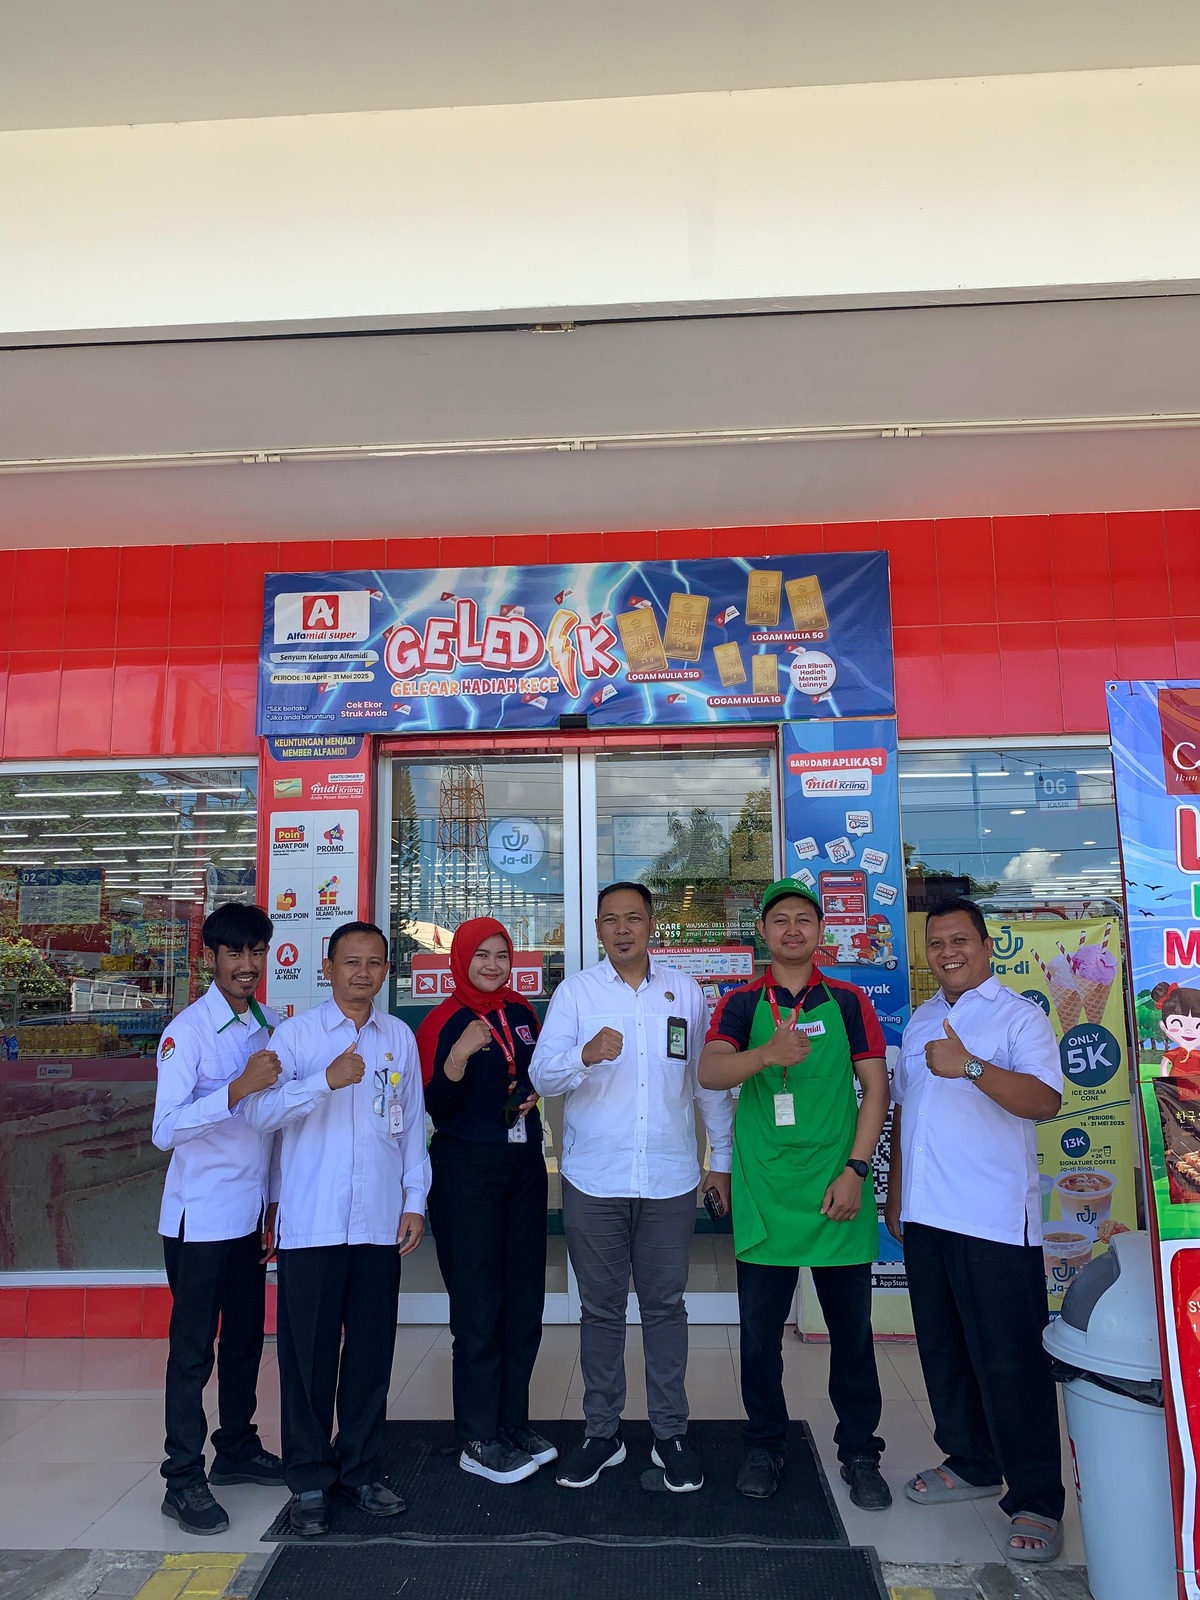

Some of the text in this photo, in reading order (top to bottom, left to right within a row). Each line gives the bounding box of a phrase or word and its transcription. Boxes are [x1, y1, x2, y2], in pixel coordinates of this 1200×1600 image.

[752, 590, 774, 598] FINE
[673, 619, 697, 629] FINE
[286, 631, 357, 641] Alfamidi super
[671, 627, 696, 636] GOLD
[280, 651, 368, 662] Senyum Keluarga Alfamidi
[312, 673, 327, 682] April
[628, 673, 657, 681] LOGAM
[657, 672, 683, 680] MULIA
[391, 680, 460, 697] GELEGAR
[519, 676, 559, 693] KECE
[799, 681, 828, 689] Lainnya
[346, 701, 383, 709] Cek Ekor
[709, 695, 782, 705] LOGAM MULIA 1G
[301, 713, 335, 721] beruntung
[341, 709, 388, 718] Struk Anda
[274, 736, 356, 747] KEUNTUNGAN MENJADI
[282, 747, 347, 758] MEMBER ALFAMIDI
[810, 759, 831, 767] DARI
[832, 757, 883, 767] APLIKASI
[805, 776, 838, 789] midi
[1175, 773, 1198, 782] Ikan
[311, 782, 339, 793] midi
[1043, 778, 1068, 795] 06
[1047, 801, 1070, 809] KASIR
[278, 829, 300, 839] Poin
[500, 853, 533, 866] Ja-di
[23, 873, 37, 883] 02
[859, 984, 890, 997] nyak
[878, 1015, 901, 1024] ikriing
[1068, 1033, 1100, 1047] ONLY
[1067, 1042, 1113, 1074] 5K
[1175, 1110, 1200, 1124] 한국
[1063, 1136, 1086, 1149] 13K
[879, 1279, 892, 1287] App
[1051, 1283, 1068, 1292] Ja-
